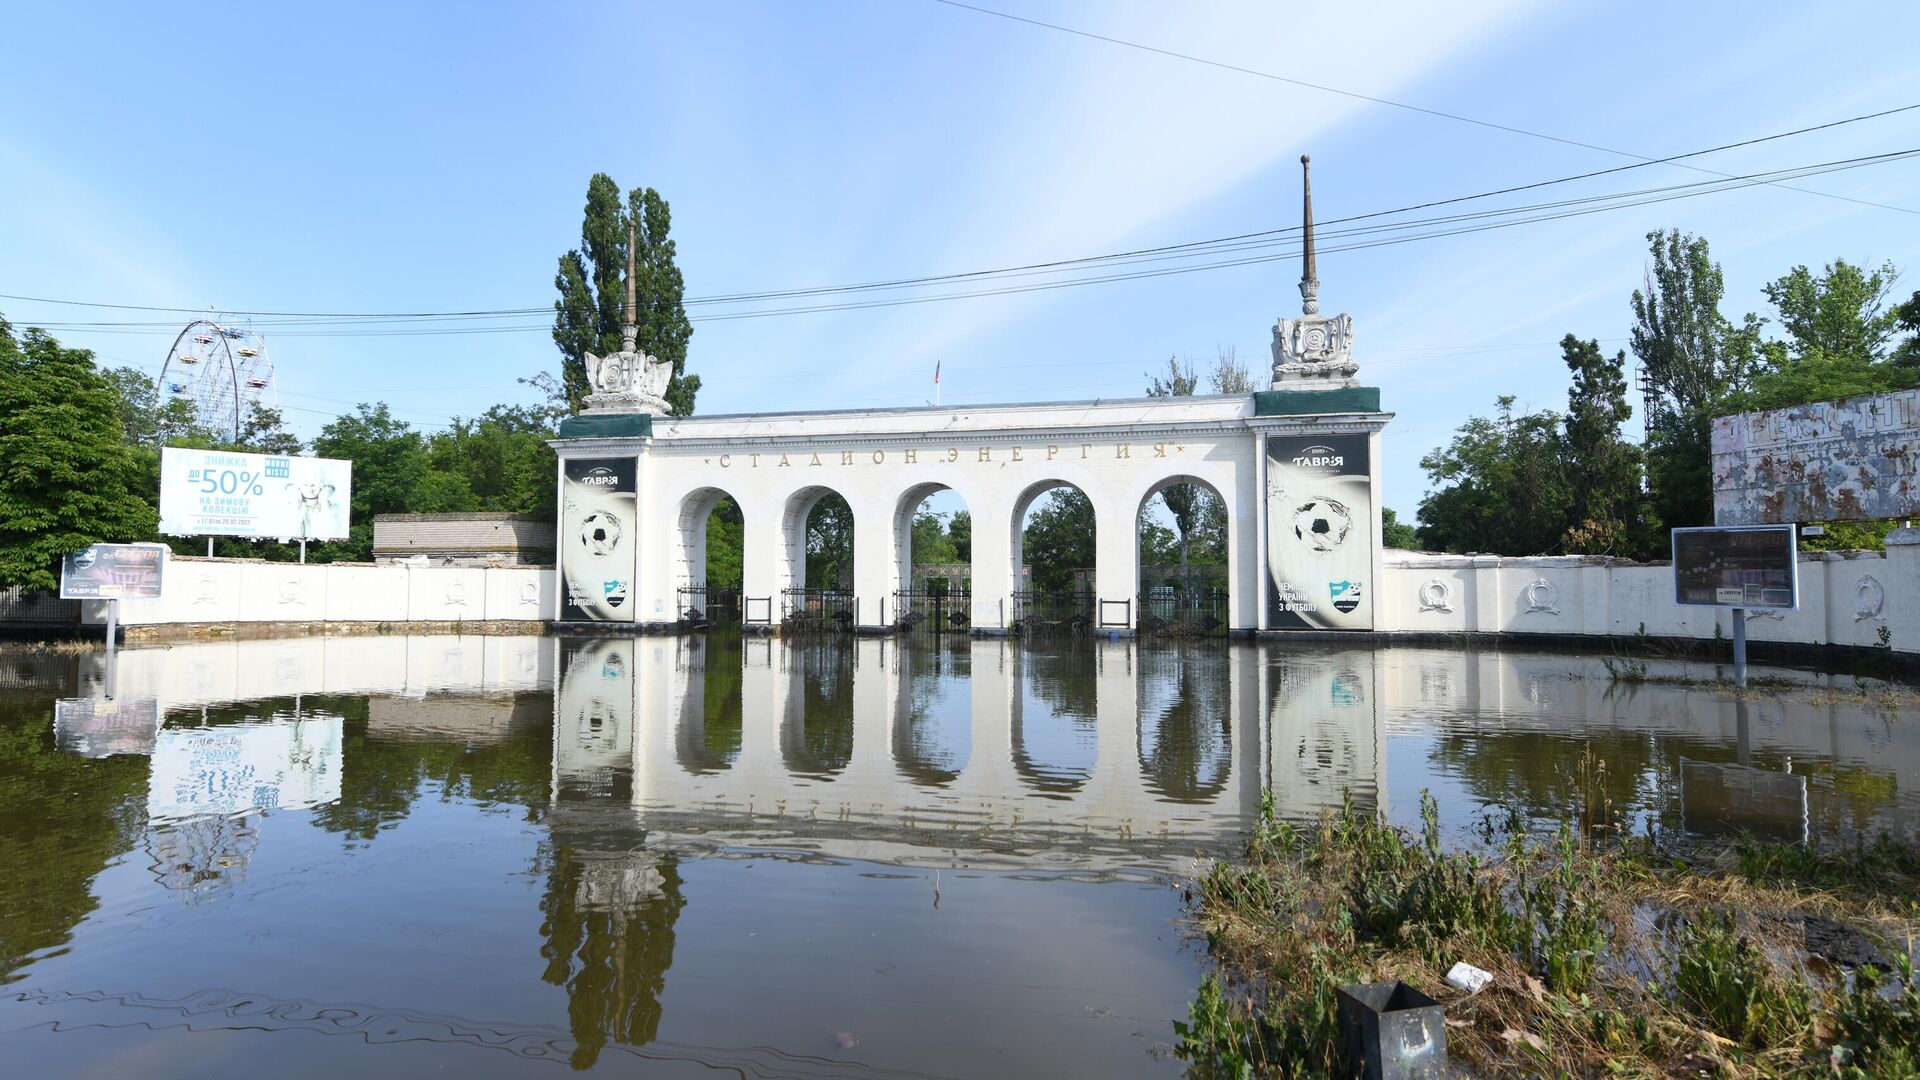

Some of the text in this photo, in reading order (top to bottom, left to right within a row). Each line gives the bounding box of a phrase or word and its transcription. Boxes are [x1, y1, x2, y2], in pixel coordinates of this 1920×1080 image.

[205, 455, 247, 467] ЗНИЖКА
[719, 448, 917, 468] СТАДИОН
[199, 497, 250, 506] НА ЗИМОВУ
[202, 505, 249, 515] КОЛЕКЦІЮ
[1278, 591, 1308, 601] УКРАЇНИ
[1278, 602, 1318, 612] З ФУТБОЛУ
